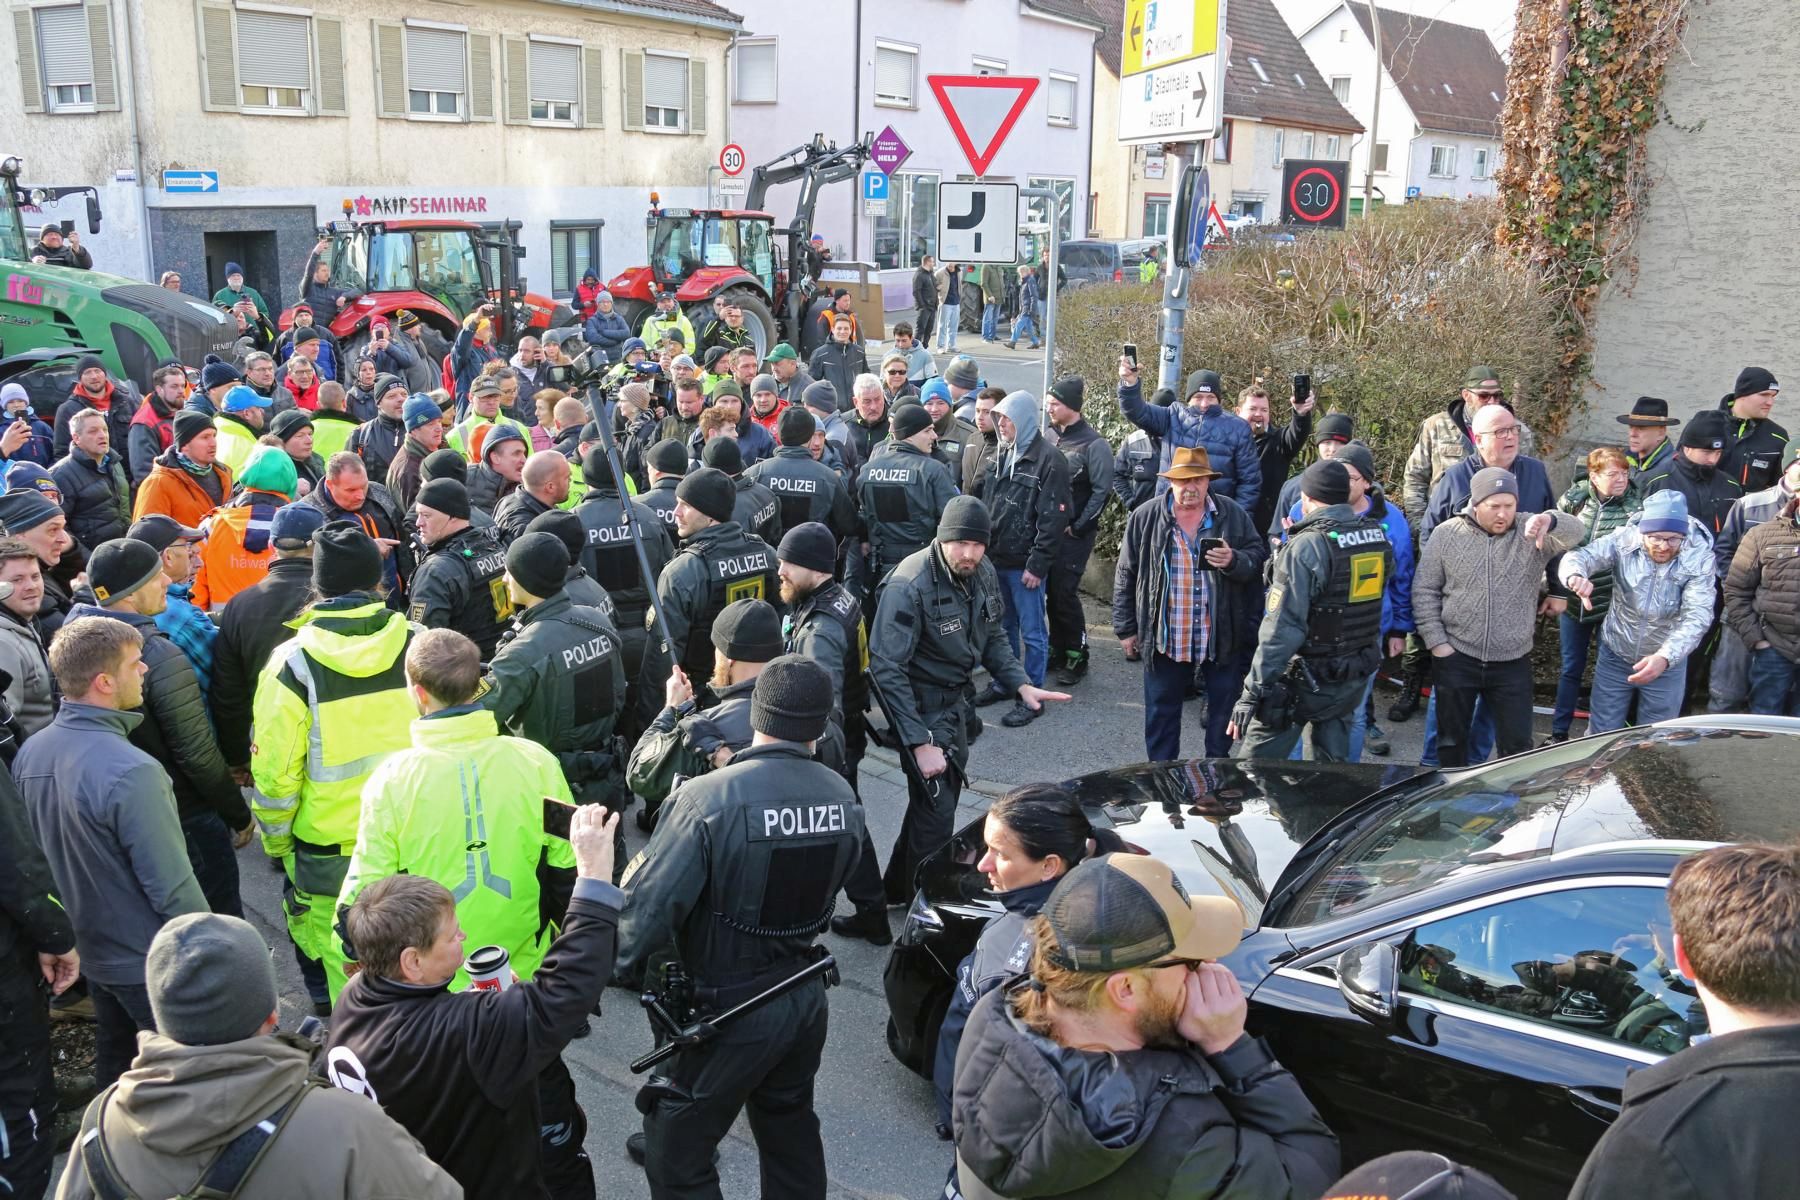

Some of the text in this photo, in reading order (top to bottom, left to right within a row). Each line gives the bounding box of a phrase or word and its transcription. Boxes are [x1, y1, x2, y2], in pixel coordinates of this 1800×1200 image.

[1155, 71, 1189, 95] Stadthalle
[1149, 107, 1175, 127] Altstadt
[725, 152, 740, 167] 30
[877, 154, 898, 162] HELD
[870, 176, 883, 196] P
[1300, 182, 1329, 206] 30
[410, 196, 487, 214] SEMINAR
[212, 341, 233, 351] FENDT
[769, 476, 817, 494] POLIZEI
[868, 468, 910, 482] POLIZEI
[753, 501, 777, 529] POLIZEI
[588, 523, 643, 544] POLIZI
[1337, 529, 1385, 548] POLIZEI
[718, 551, 769, 578] POLIZEI
[763, 804, 846, 836] POLIZEI
